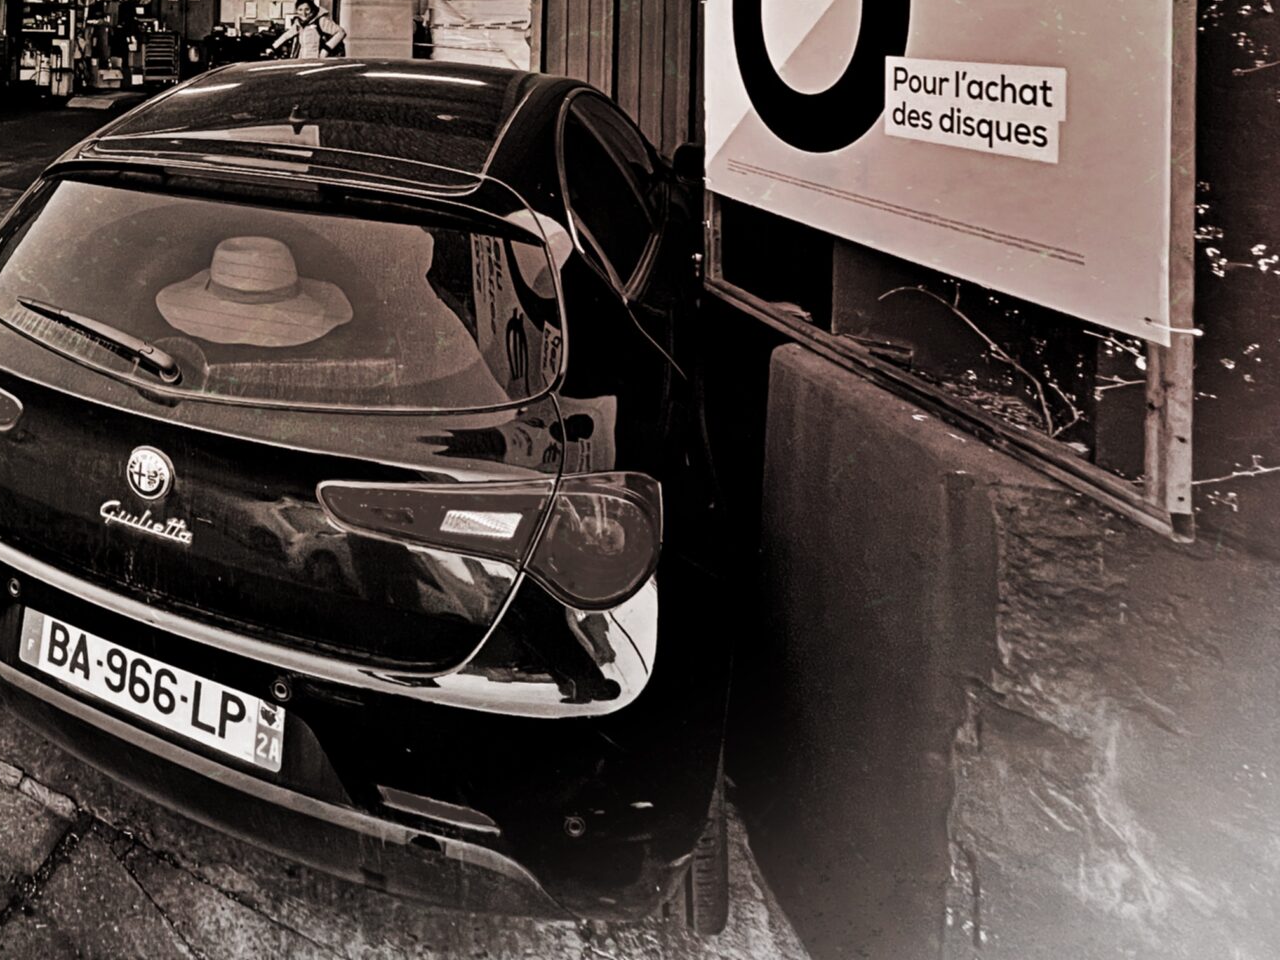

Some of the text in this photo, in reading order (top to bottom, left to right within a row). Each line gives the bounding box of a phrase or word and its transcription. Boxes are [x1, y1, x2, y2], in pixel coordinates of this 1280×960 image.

[893, 66, 1053, 108] Pour l'achat
[892, 101, 1048, 149] des disques
[99, 499, 194, 544] Giulietta
[47, 620, 247, 739] BA-966-LP
[255, 732, 281, 763] 2A
